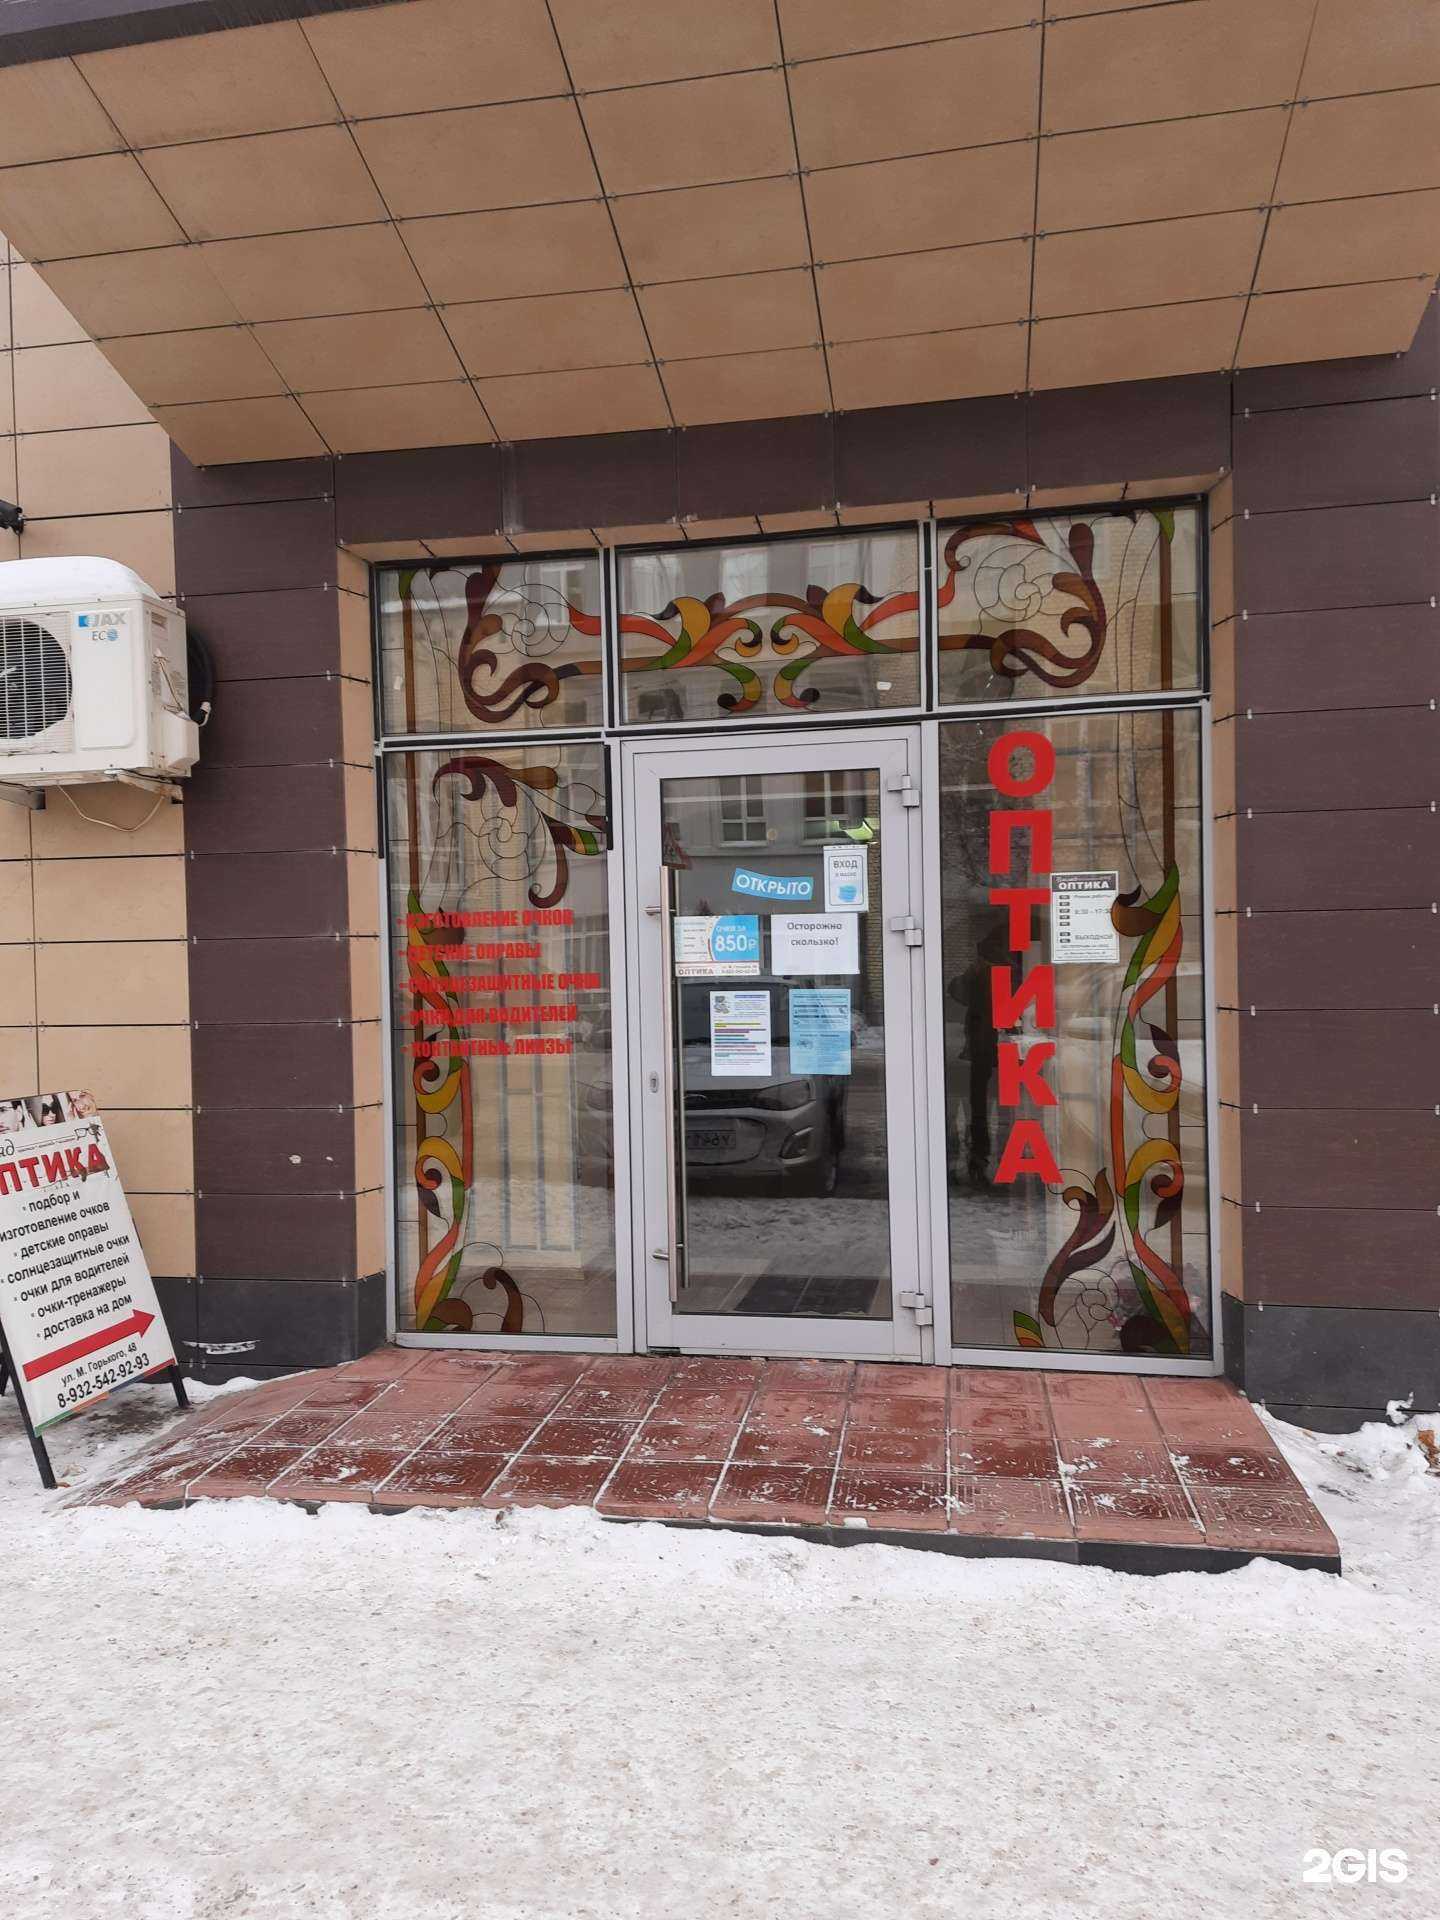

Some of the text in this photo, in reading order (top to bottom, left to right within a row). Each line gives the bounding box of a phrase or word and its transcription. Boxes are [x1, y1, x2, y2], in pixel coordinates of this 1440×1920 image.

[833, 859, 858, 870] ВХОД
[736, 874, 811, 896] ОТКРЫТО
[1058, 881, 1110, 890] ОПТИКА
[787, 922, 842, 931] Осторожно
[790, 937, 839, 946] скользко!
[476, 942, 542, 960] ОПРАВЫ
[987, 730, 1064, 1185] ОПТИКА
[514, 1038, 573, 1056] ЛИНЗЫ
[0, 1143, 110, 1196] ПТИКА
[29, 1190, 80, 1212] подбор и
[0, 1202, 110, 1242] изготовление очков
[20, 1222, 109, 1259] детские оправы
[7, 1235, 130, 1284] солнцезащитные очки
[20, 1252, 130, 1301] очки для водителей
[37, 1276, 127, 1317] очки-тренажеры
[43, 1294, 133, 1340] доставка на дом
[57, 1352, 150, 1408] 8-932-542-92-93
[61, 1342, 138, 1387] ул. М. Горького, 48
